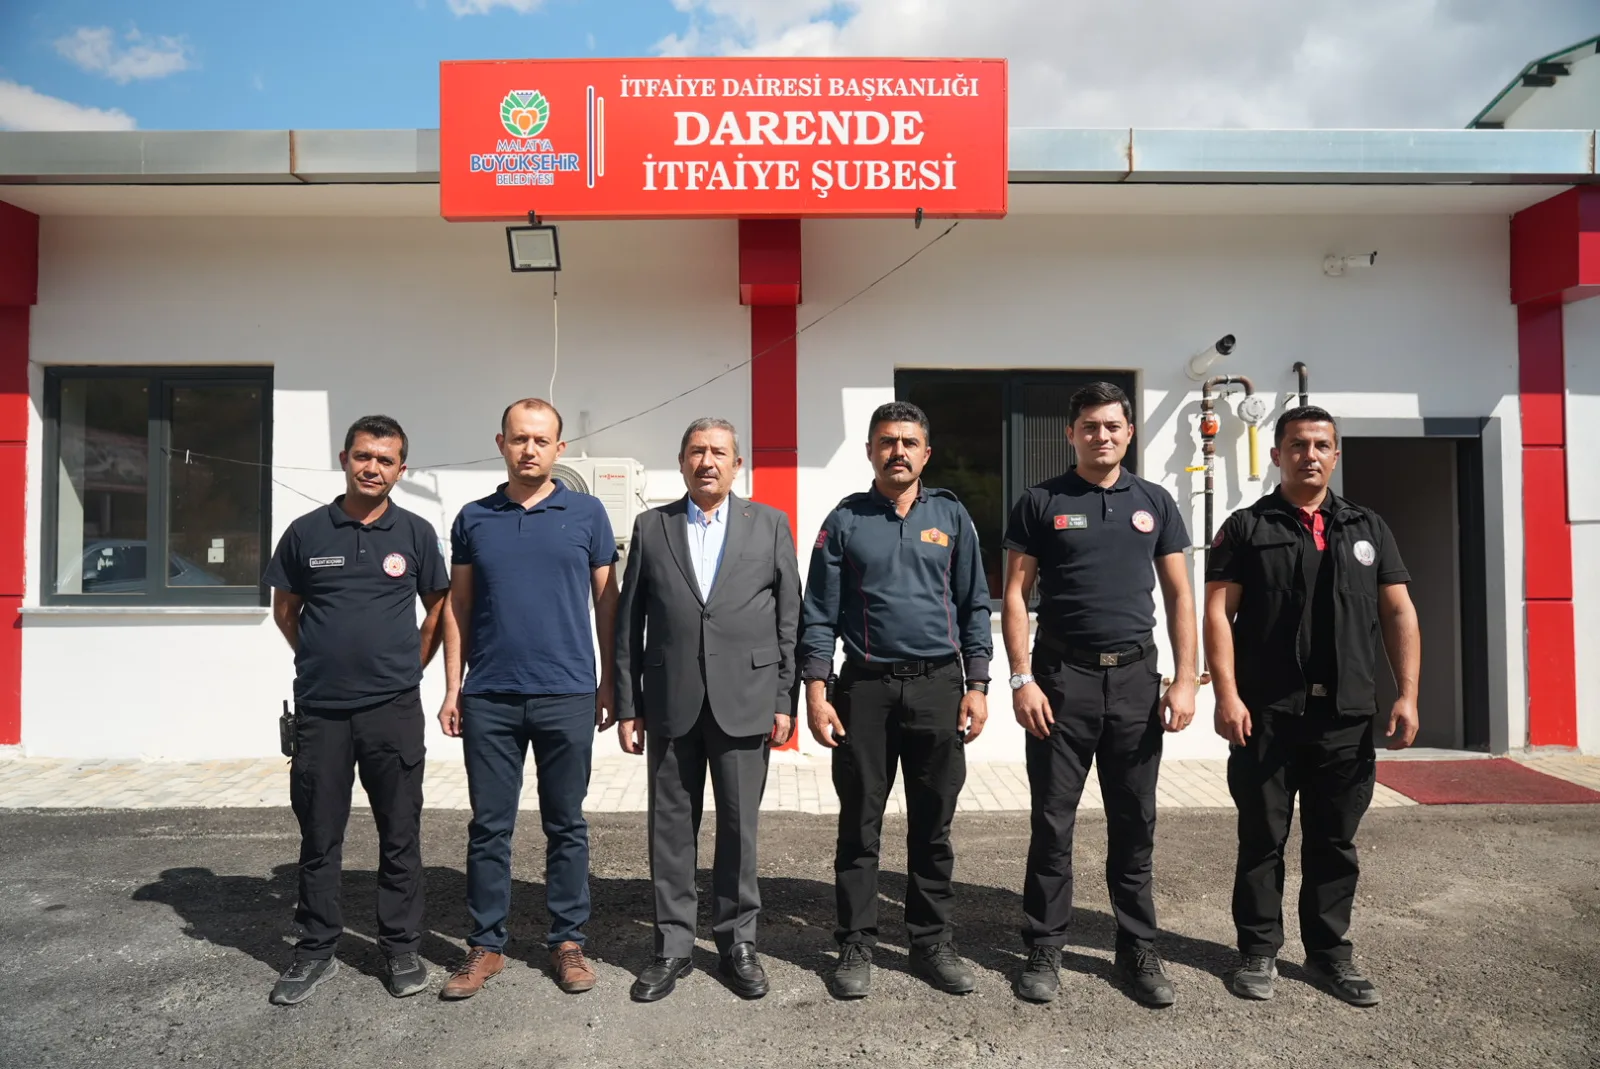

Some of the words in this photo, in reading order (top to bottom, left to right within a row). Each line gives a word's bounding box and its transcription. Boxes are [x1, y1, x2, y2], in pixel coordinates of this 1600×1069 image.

[620, 74, 716, 97] İTFAİYE
[722, 73, 822, 97] DAİRESİ
[828, 73, 979, 101] BAŞKANLIĞI
[674, 111, 925, 146] DARENDE
[496, 139, 553, 152] MALATYA
[470, 153, 580, 173] BÜYÜKŞEHİR
[642, 153, 800, 190] İTFAİYE
[811, 152, 957, 198] ŞUBESİ
[496, 173, 554, 186] BELEDİYESİ
